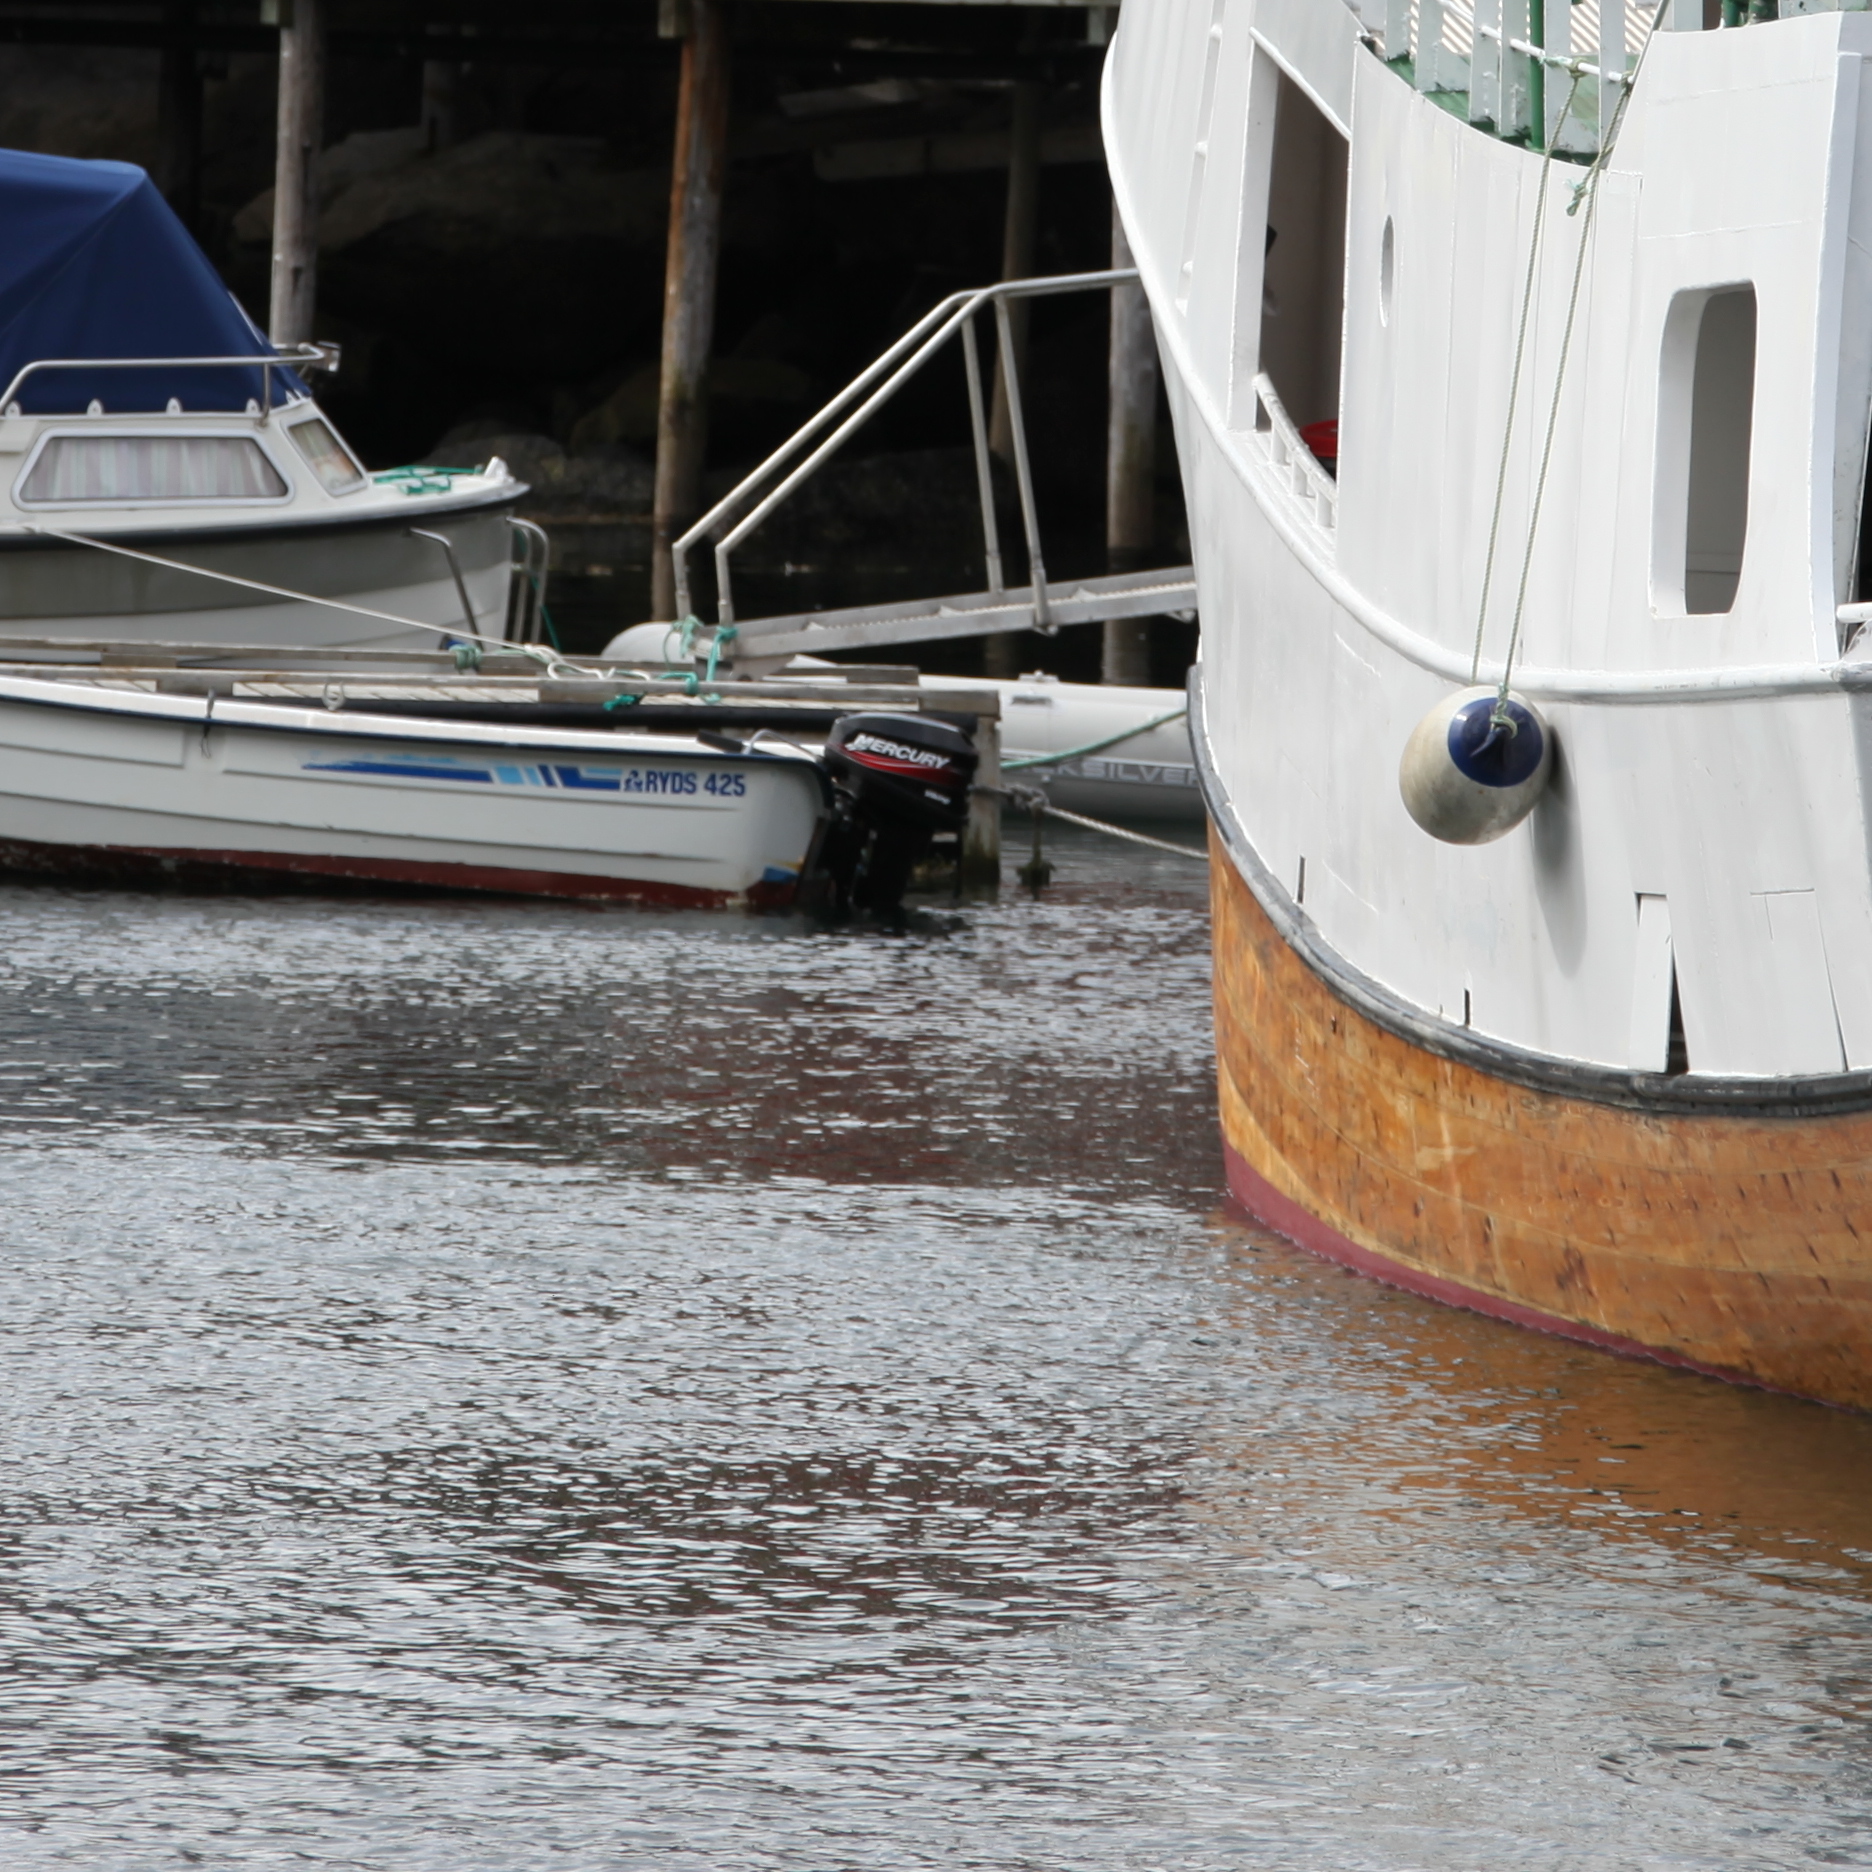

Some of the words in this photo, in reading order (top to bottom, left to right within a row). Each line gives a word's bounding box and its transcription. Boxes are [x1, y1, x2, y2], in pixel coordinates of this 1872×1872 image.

[851, 733, 951, 769] MERCURY
[645, 770, 697, 794] RYDS
[704, 773, 746, 796] 425
